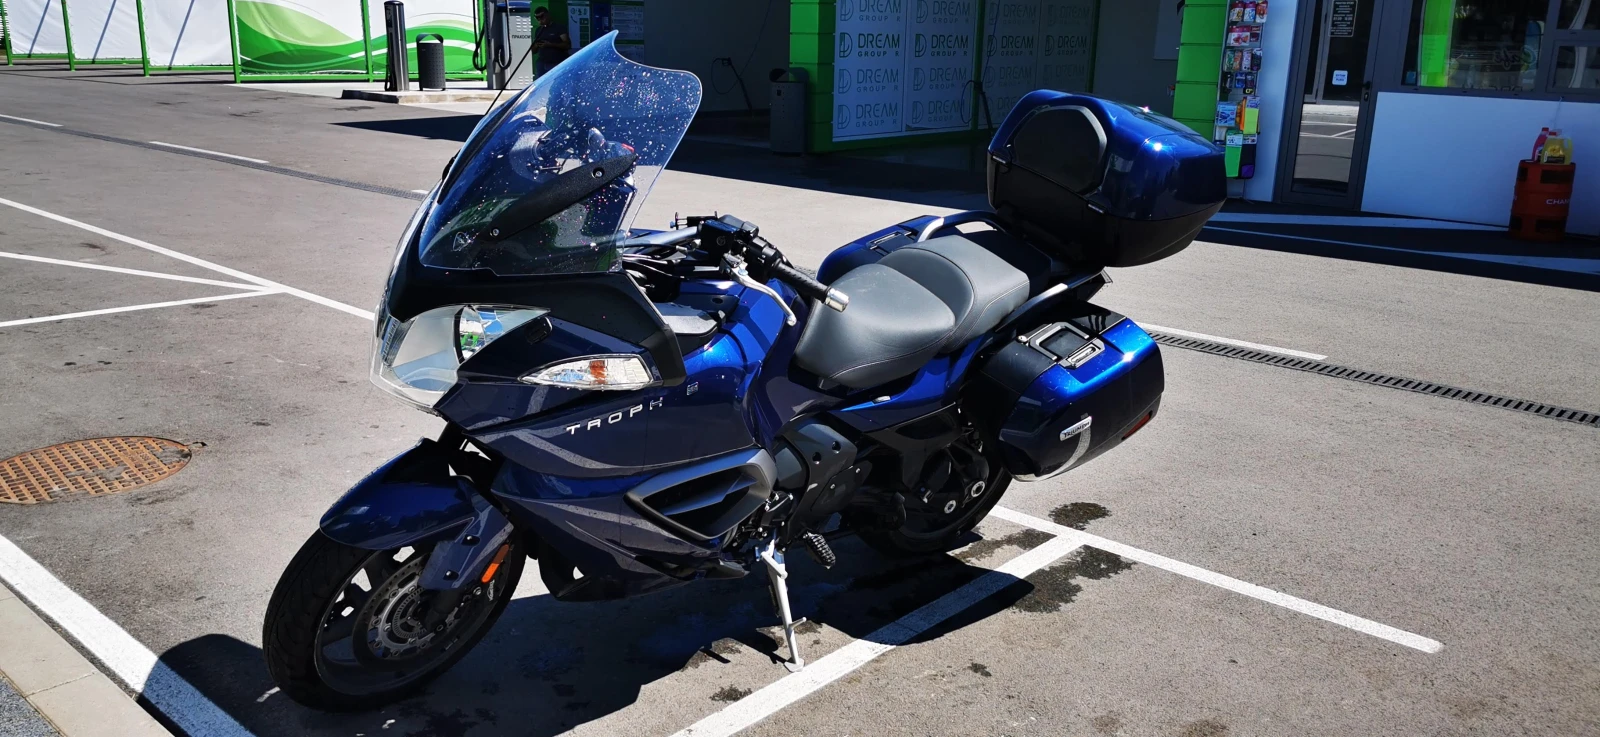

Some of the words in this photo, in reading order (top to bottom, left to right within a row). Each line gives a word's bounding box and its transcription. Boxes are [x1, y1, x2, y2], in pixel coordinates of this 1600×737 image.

[859, 0, 902, 14] DREAM
[932, 1, 971, 16] DREAM
[858, 33, 900, 49] DREAM
[931, 34, 969, 49] DREAM
[1001, 35, 1035, 49] DREAM
[1057, 35, 1088, 48] DREAM
[857, 68, 899, 84] DREAM
[929, 67, 967, 82] DREAM
[856, 85, 886, 93] GROUP
[929, 83, 955, 91] GROUP
[856, 102, 898, 119] DREAM
[855, 119, 885, 128] GROUP
